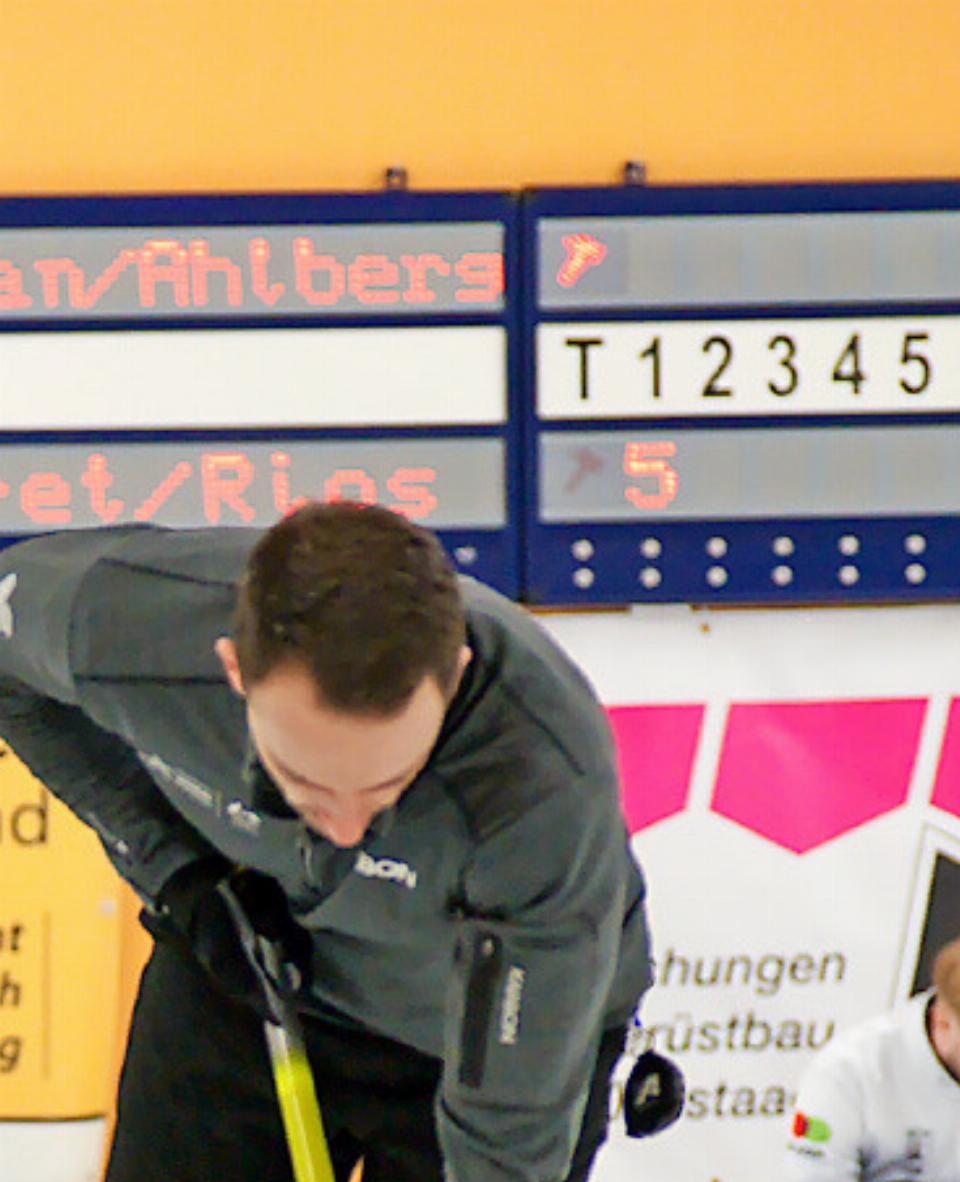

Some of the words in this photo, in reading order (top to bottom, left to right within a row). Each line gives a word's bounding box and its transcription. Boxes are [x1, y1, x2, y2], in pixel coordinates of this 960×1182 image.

[565, 337, 604, 400] T
[640, 336, 662, 399] 1
[701, 335, 734, 398] 2
[767, 334, 799, 397] 3
[832, 332, 866, 395] 4
[899, 332, 932, 395] 5
[623, 440, 681, 510] 5
